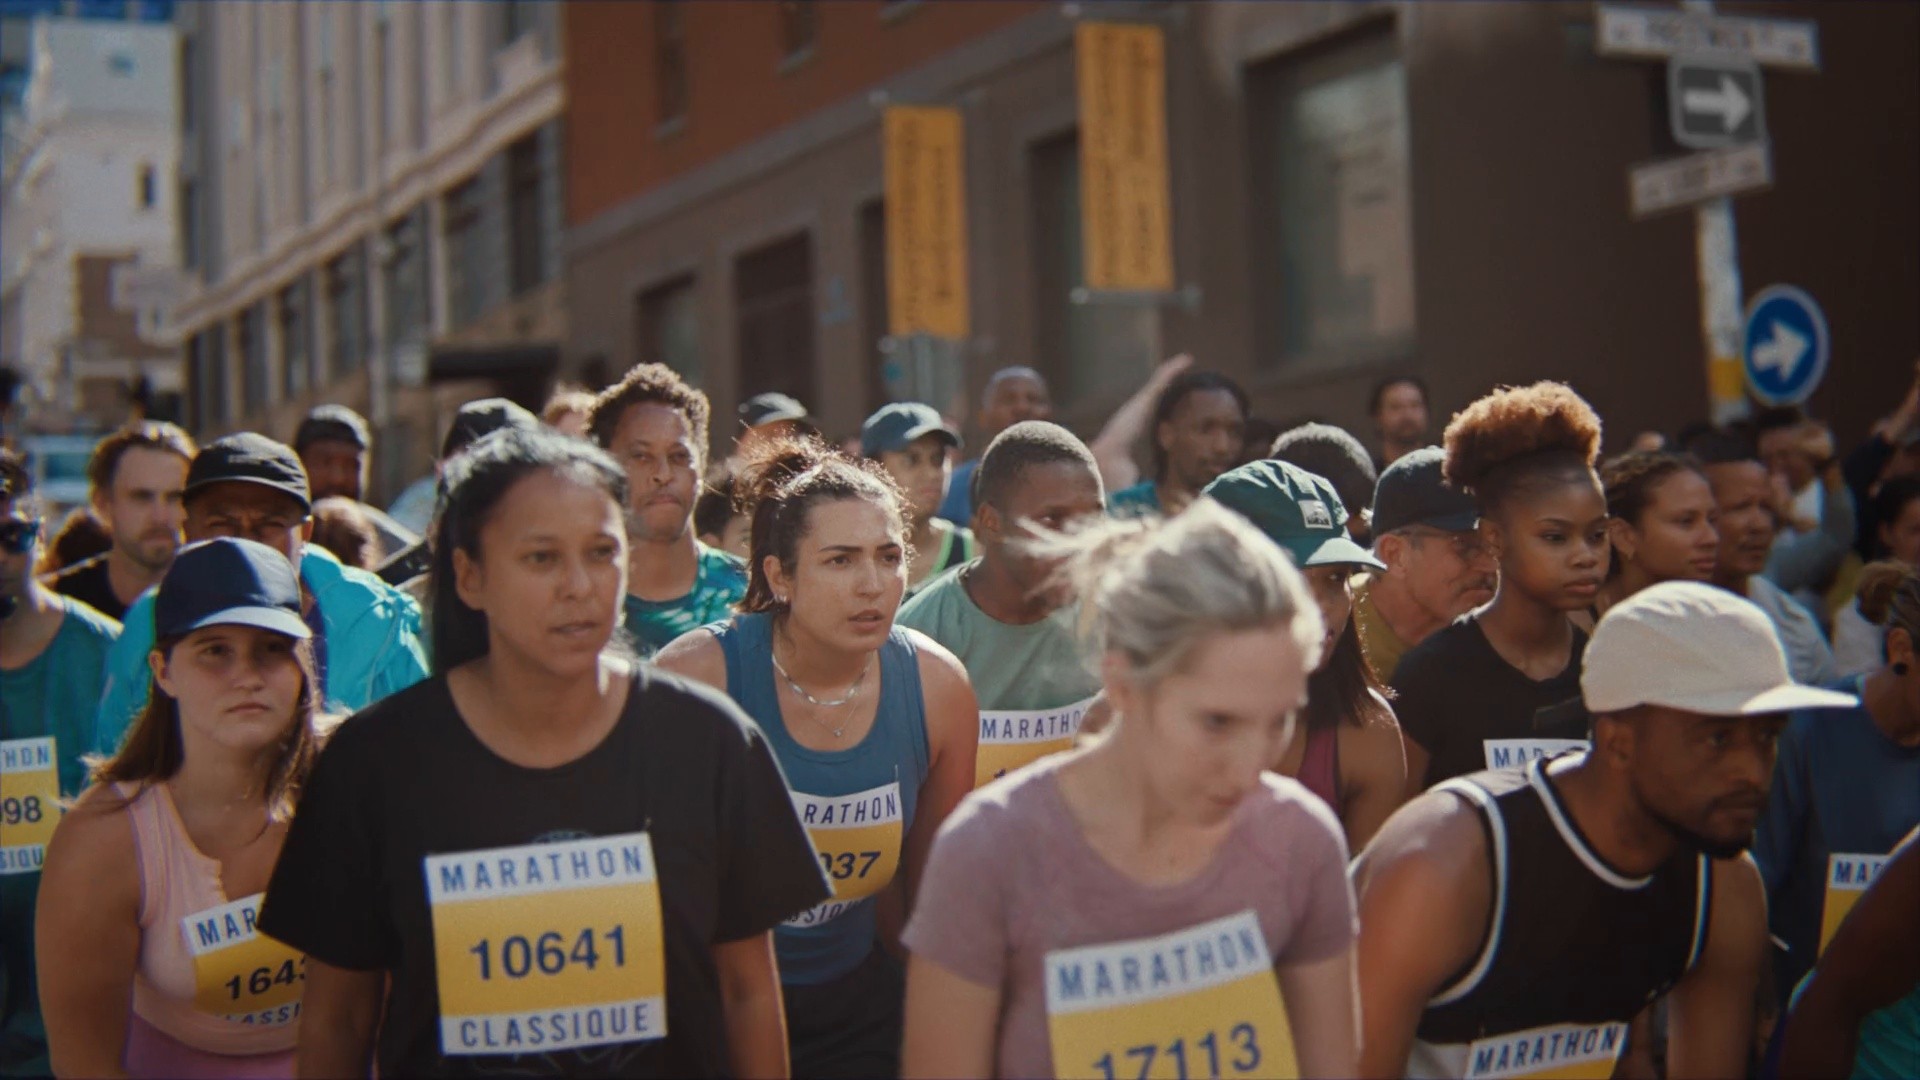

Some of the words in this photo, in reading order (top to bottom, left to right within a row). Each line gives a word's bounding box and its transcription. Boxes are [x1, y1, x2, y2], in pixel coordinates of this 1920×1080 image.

[982, 710, 1081, 739] MARATHO
[3, 745, 49, 768] HON
[0, 795, 42, 824] 98
[804, 792, 896, 824] RATHON
[441, 846, 641, 892] MARATHON
[197, 907, 257, 946] MAR
[470, 924, 625, 981] 10641
[1058, 928, 1259, 1000] MARATHON
[226, 1002, 300, 1025] ASSI
[460, 1003, 648, 1048] CLASSIQUE
[1093, 1022, 1262, 1080] 17113
[1474, 1026, 1618, 1076] MARATHON
